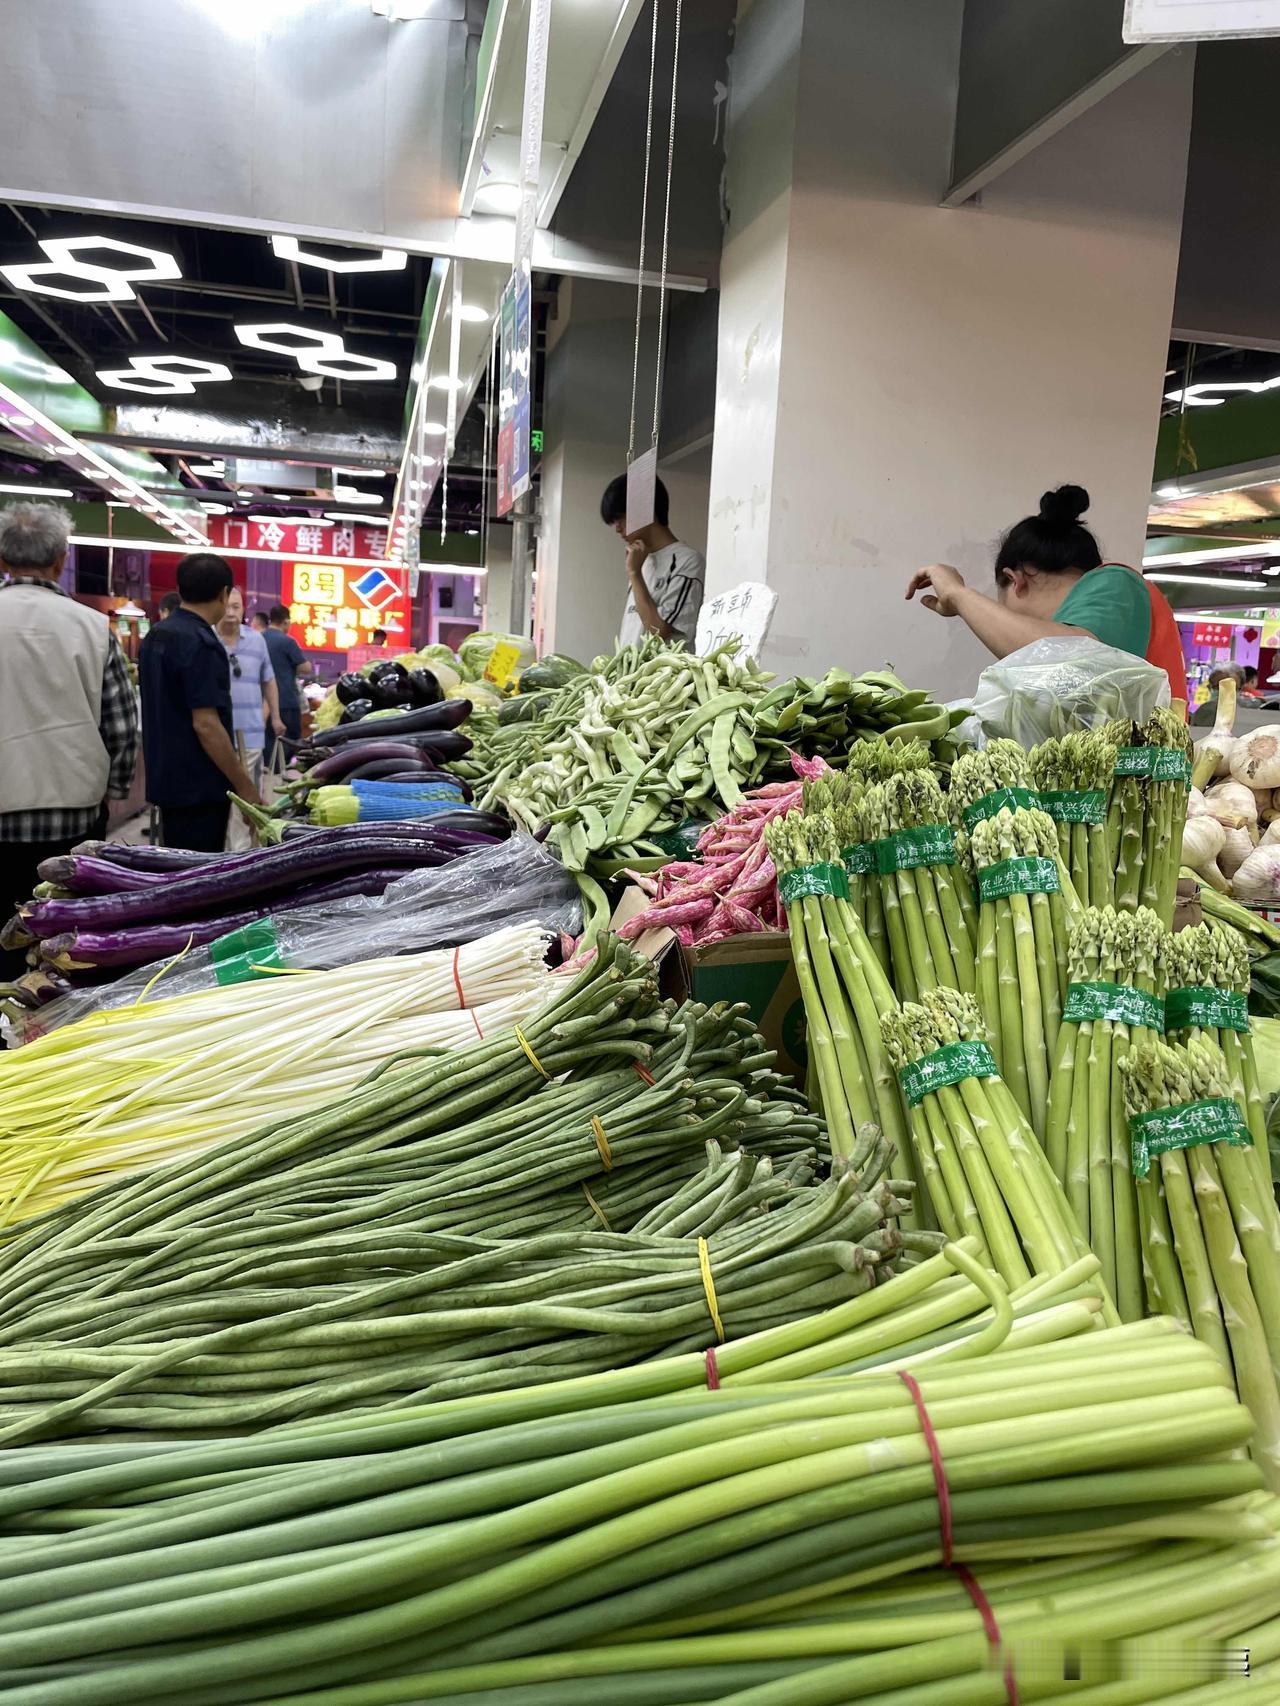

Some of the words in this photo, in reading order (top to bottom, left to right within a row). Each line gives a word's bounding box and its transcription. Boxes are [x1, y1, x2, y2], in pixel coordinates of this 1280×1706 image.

[206, 519, 389, 559] 门冷鲜肉专
[298, 571, 336, 600] 3号
